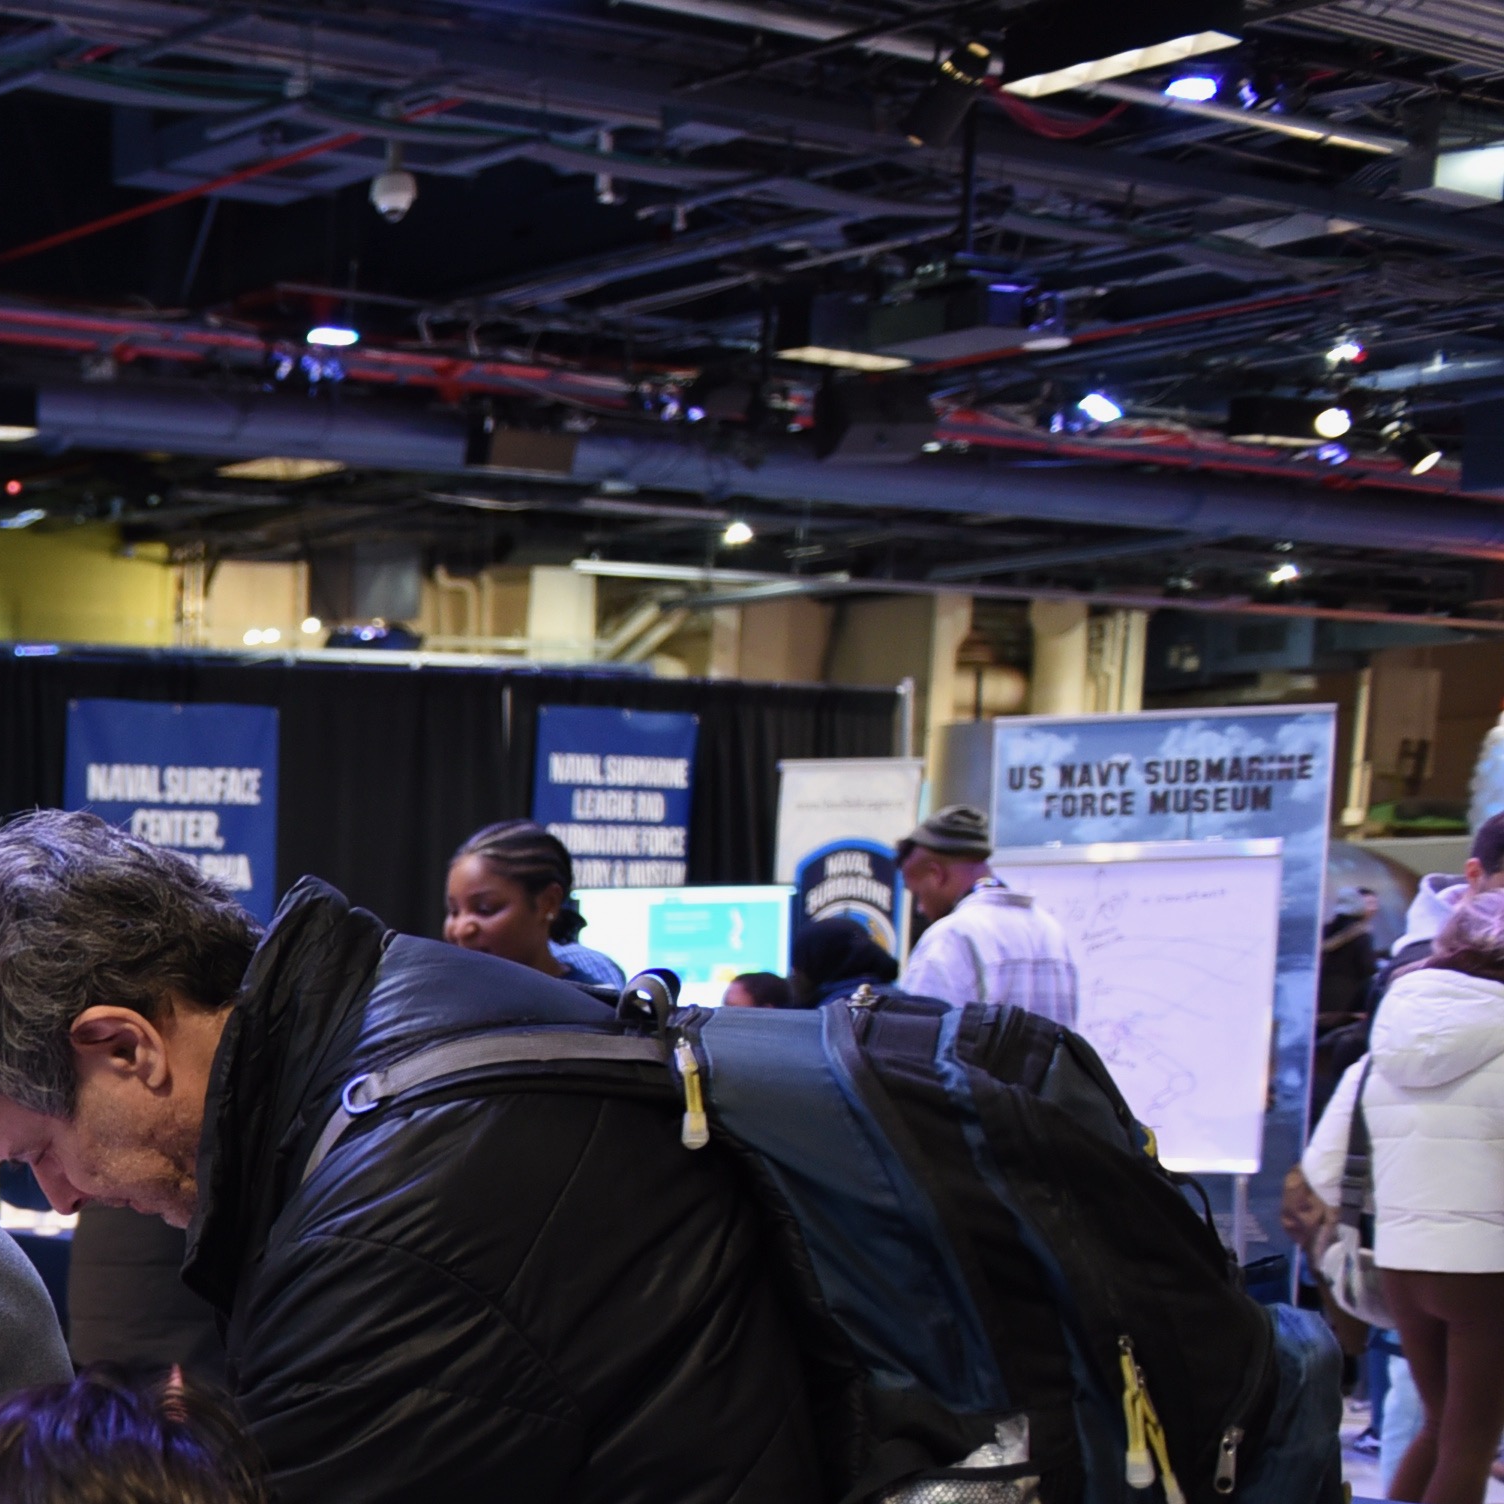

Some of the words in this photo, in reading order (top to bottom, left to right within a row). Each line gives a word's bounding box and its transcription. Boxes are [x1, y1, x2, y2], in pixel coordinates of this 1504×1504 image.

[87, 763, 162, 802] NAVAL
[163, 766, 262, 805] SURFACE
[549, 752, 604, 785] NAVAL
[1008, 766, 1043, 791] US
[1059, 762, 1130, 789] NAVY
[1144, 754, 1313, 785] SUBMARINE
[1044, 791, 1135, 819] FORCE
[1149, 786, 1273, 815] MUSEUM
[131, 808, 225, 850] CENTER,
[825, 851, 873, 878] NAVAL
[805, 876, 892, 915] SUBMARINE
